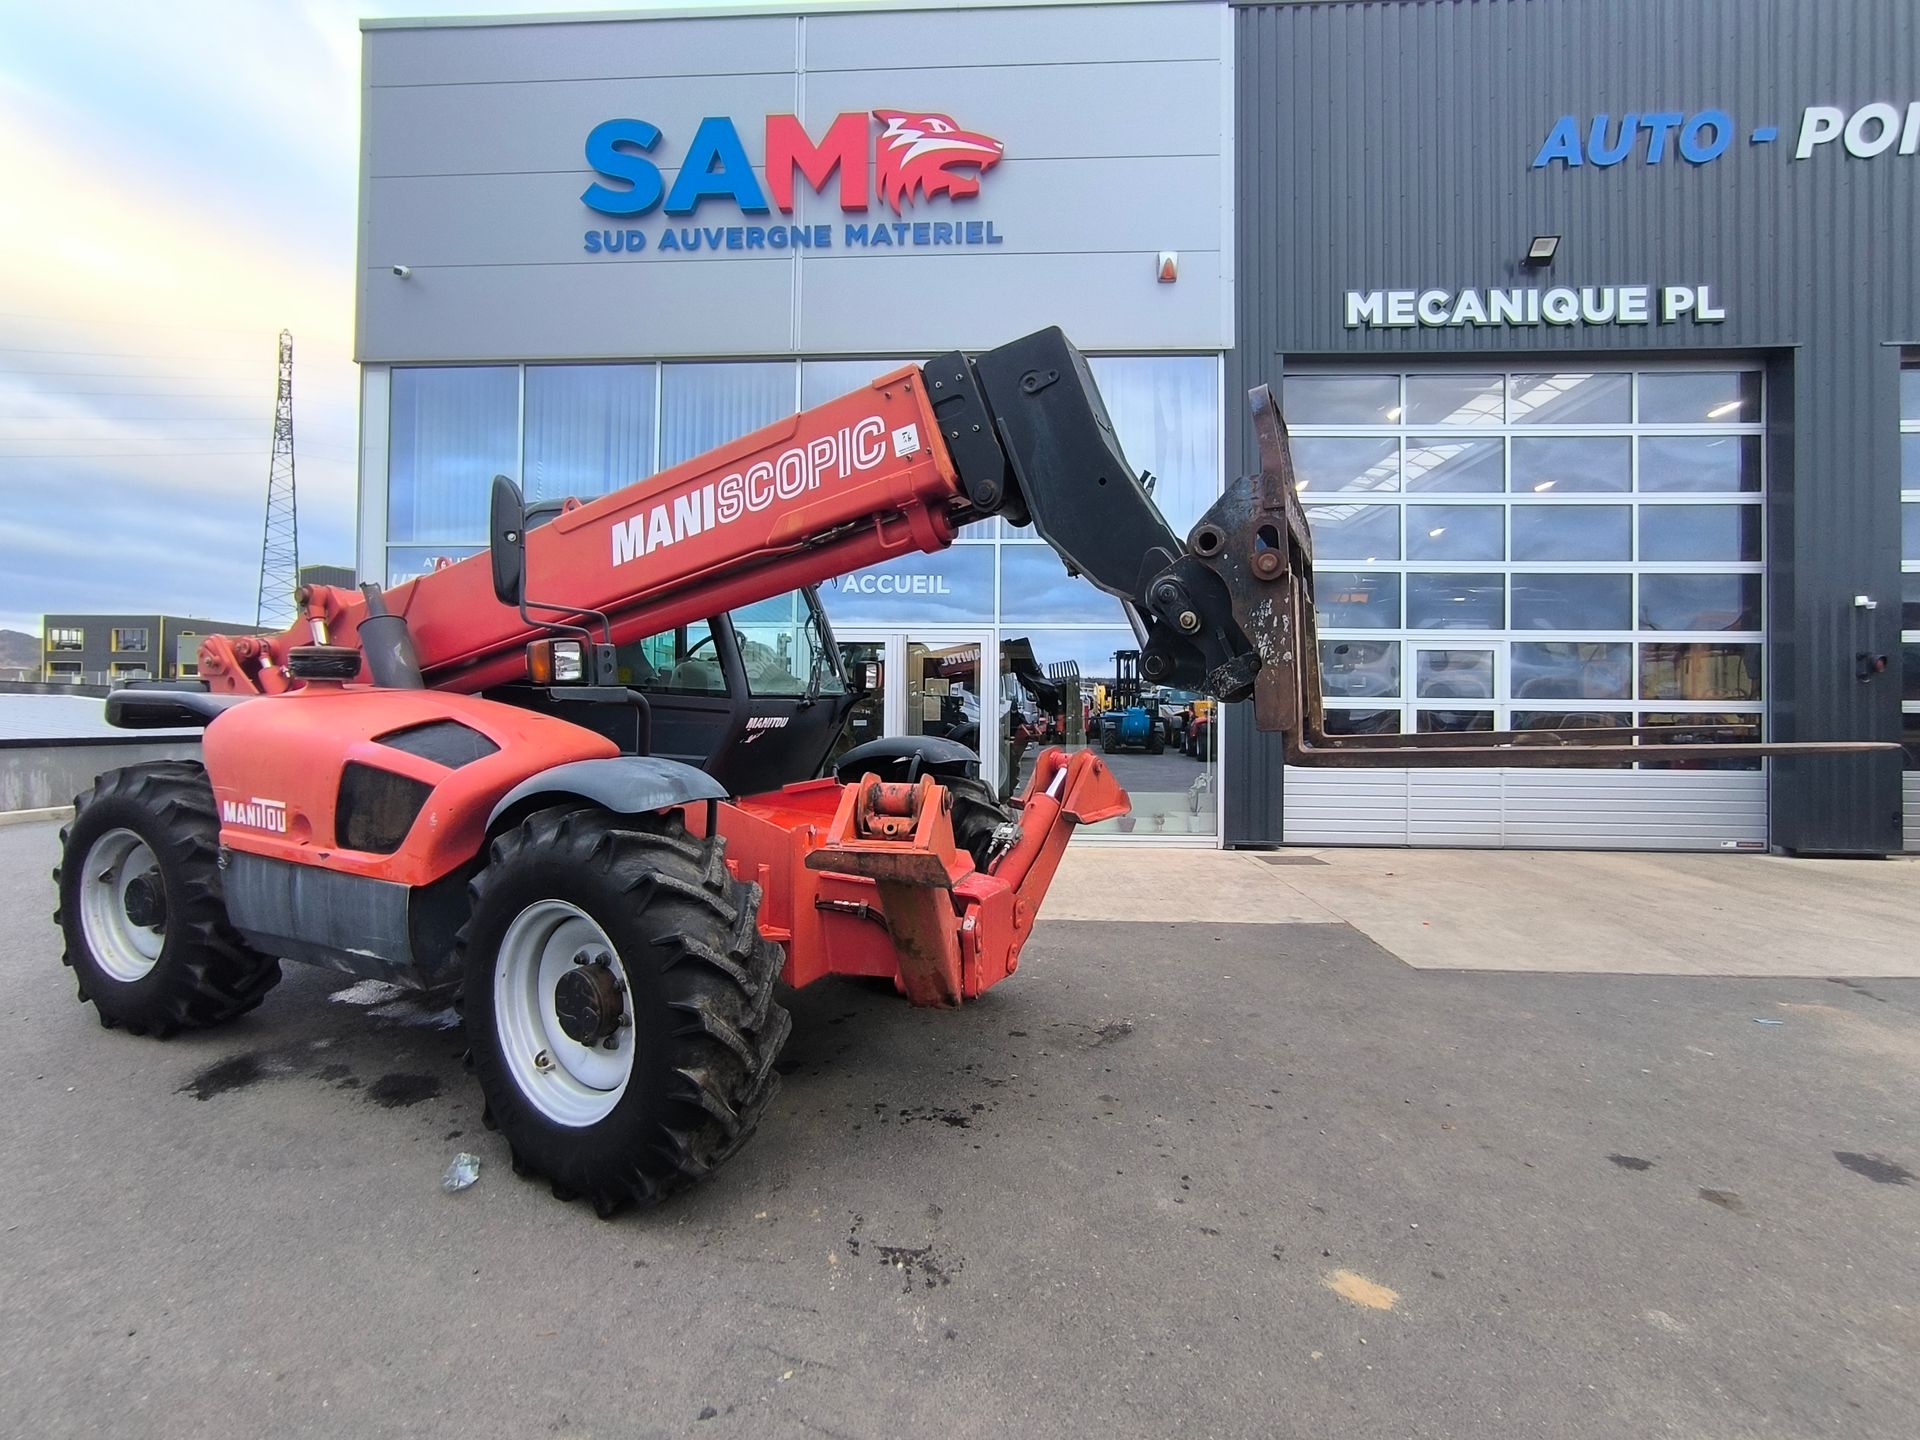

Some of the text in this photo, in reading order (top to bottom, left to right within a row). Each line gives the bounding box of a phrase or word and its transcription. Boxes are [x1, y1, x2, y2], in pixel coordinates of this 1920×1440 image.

[1533, 109, 1733, 168] AUTO
[580, 112, 869, 218] SAM
[583, 220, 1004, 253] SUD AUVERGNE MATERIEL
[1345, 285, 1725, 328] MECANIQUE PL
[612, 416, 887, 568] MANISCOPIC
[841, 574, 951, 594] ACCUEIL
[745, 716, 790, 729] MANITOU
[223, 796, 287, 833] MANITOU
